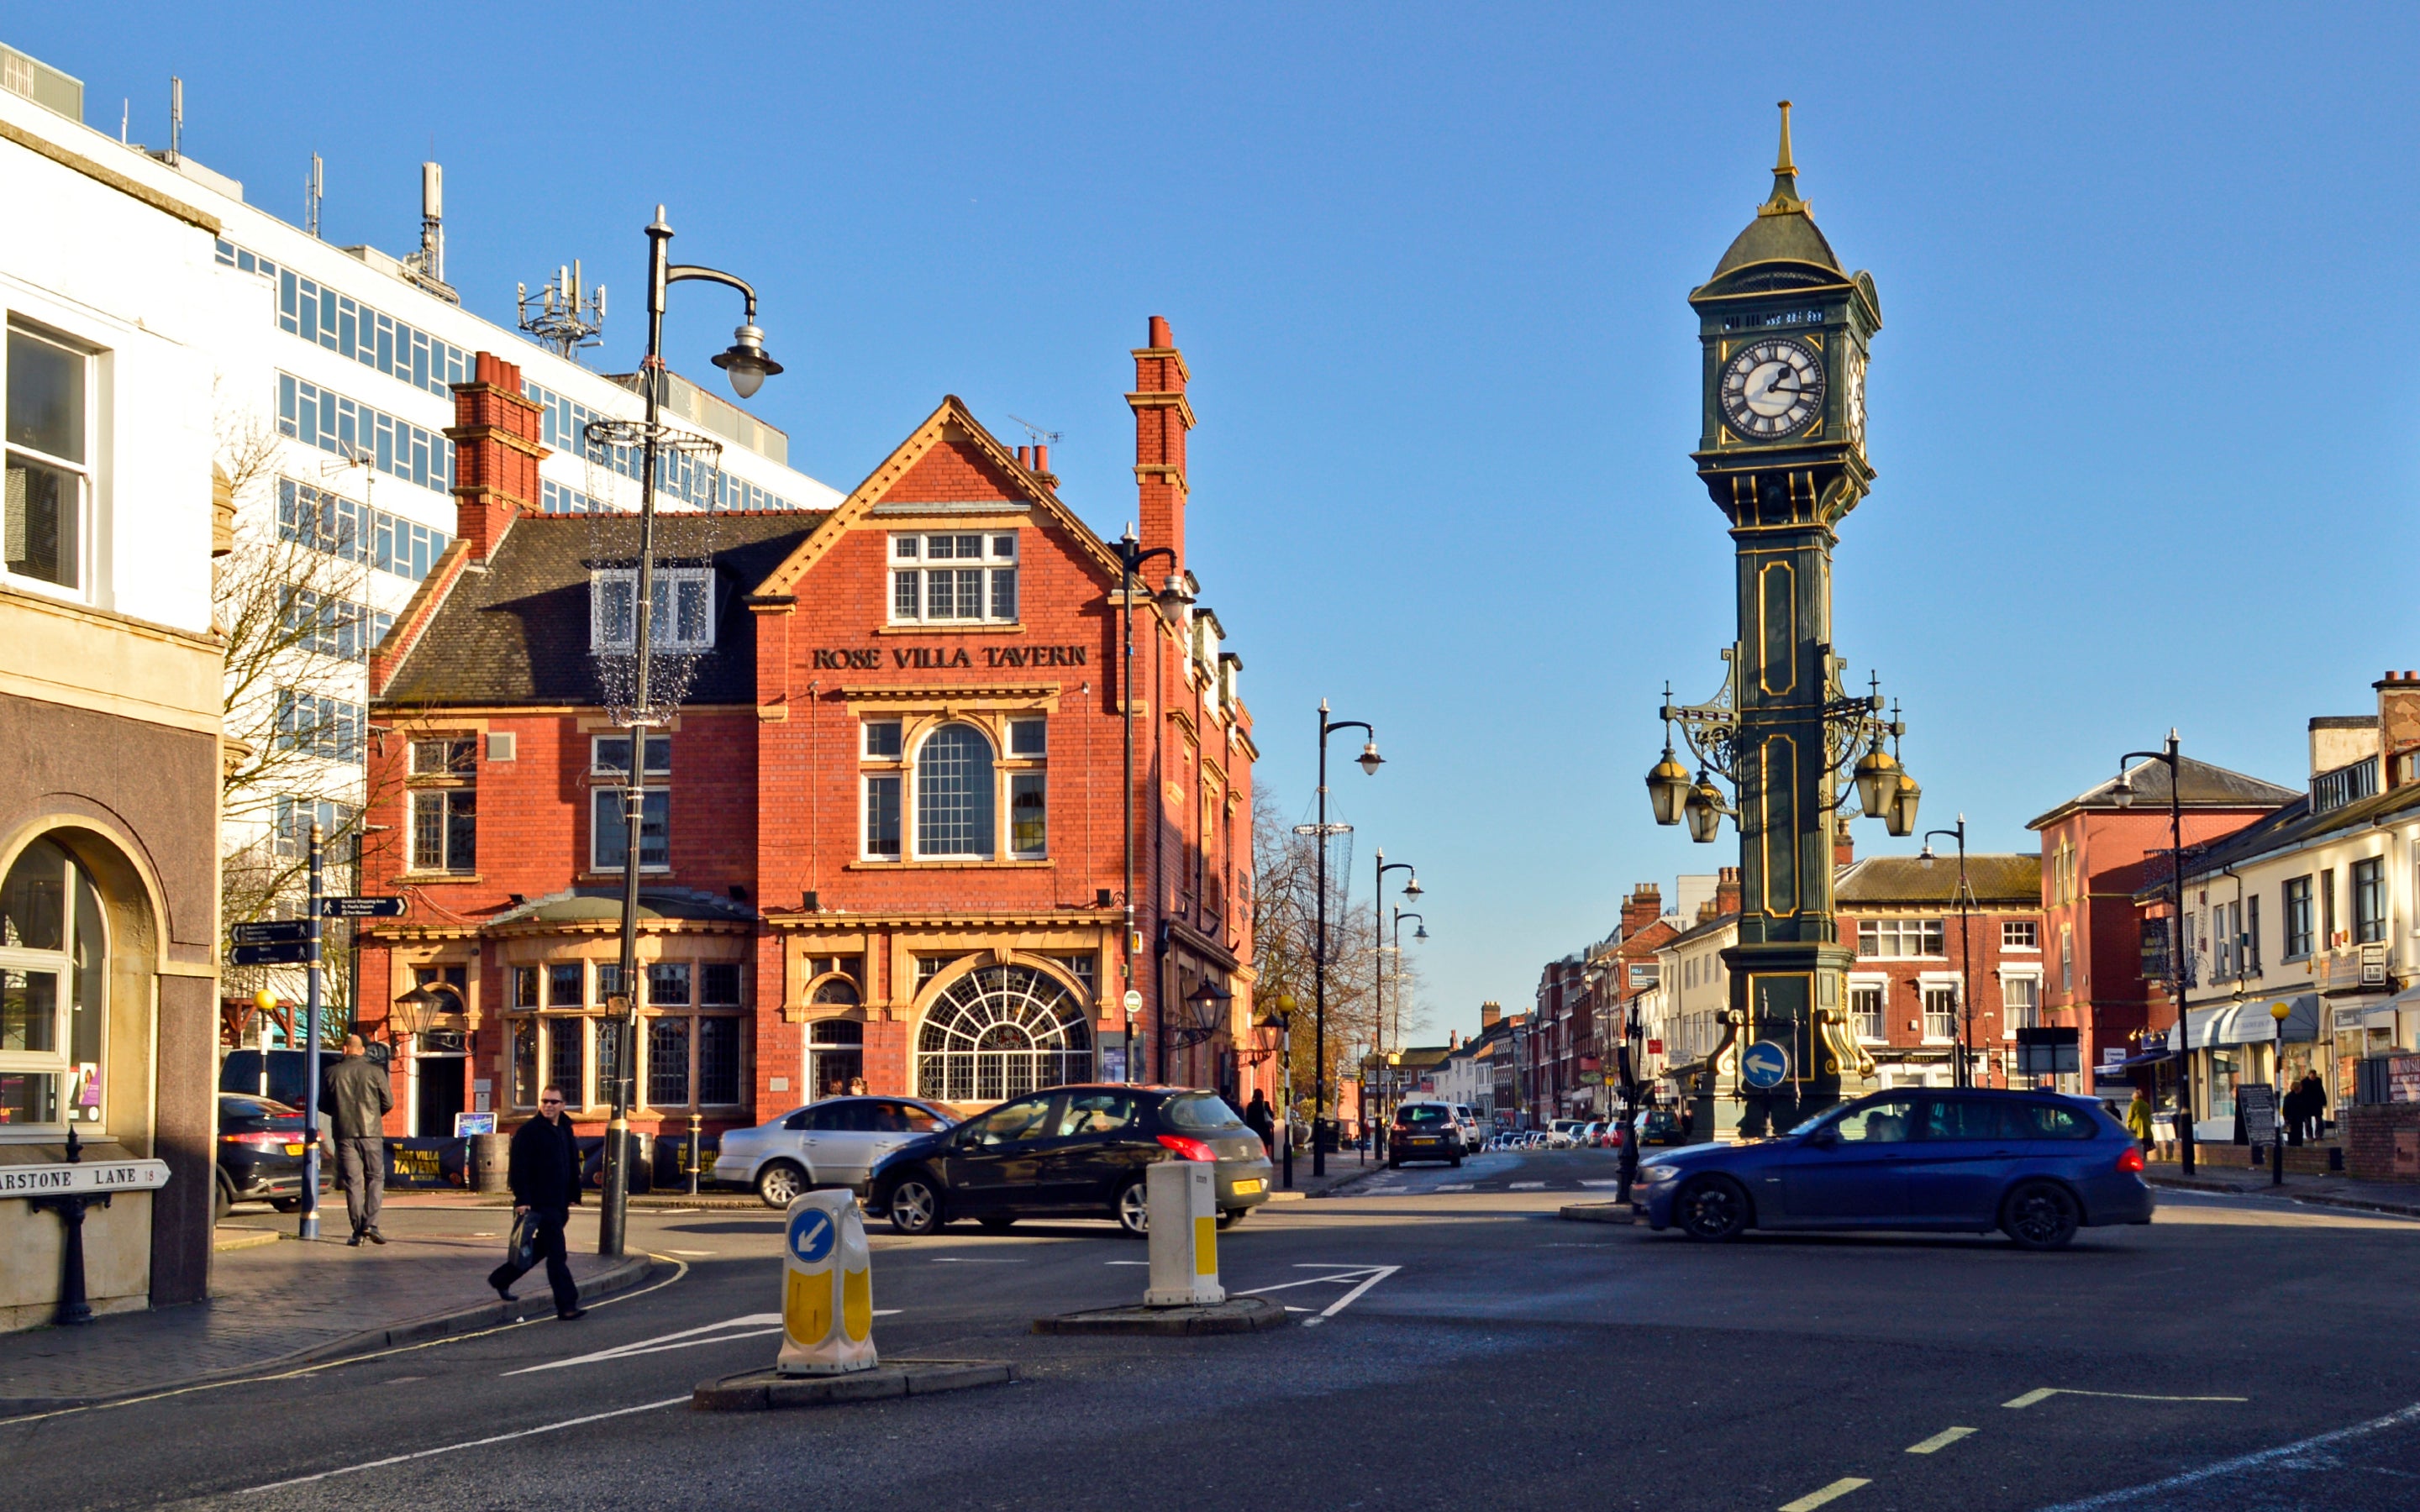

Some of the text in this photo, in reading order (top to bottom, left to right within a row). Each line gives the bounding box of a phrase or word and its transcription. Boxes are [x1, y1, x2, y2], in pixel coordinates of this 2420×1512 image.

[813, 644, 1086, 669] ROSE VILLA TAVERN
[416, 1150, 439, 1161] VILLA
[393, 1160, 439, 1174] TAVERN
[94, 1168, 136, 1184] LANE
